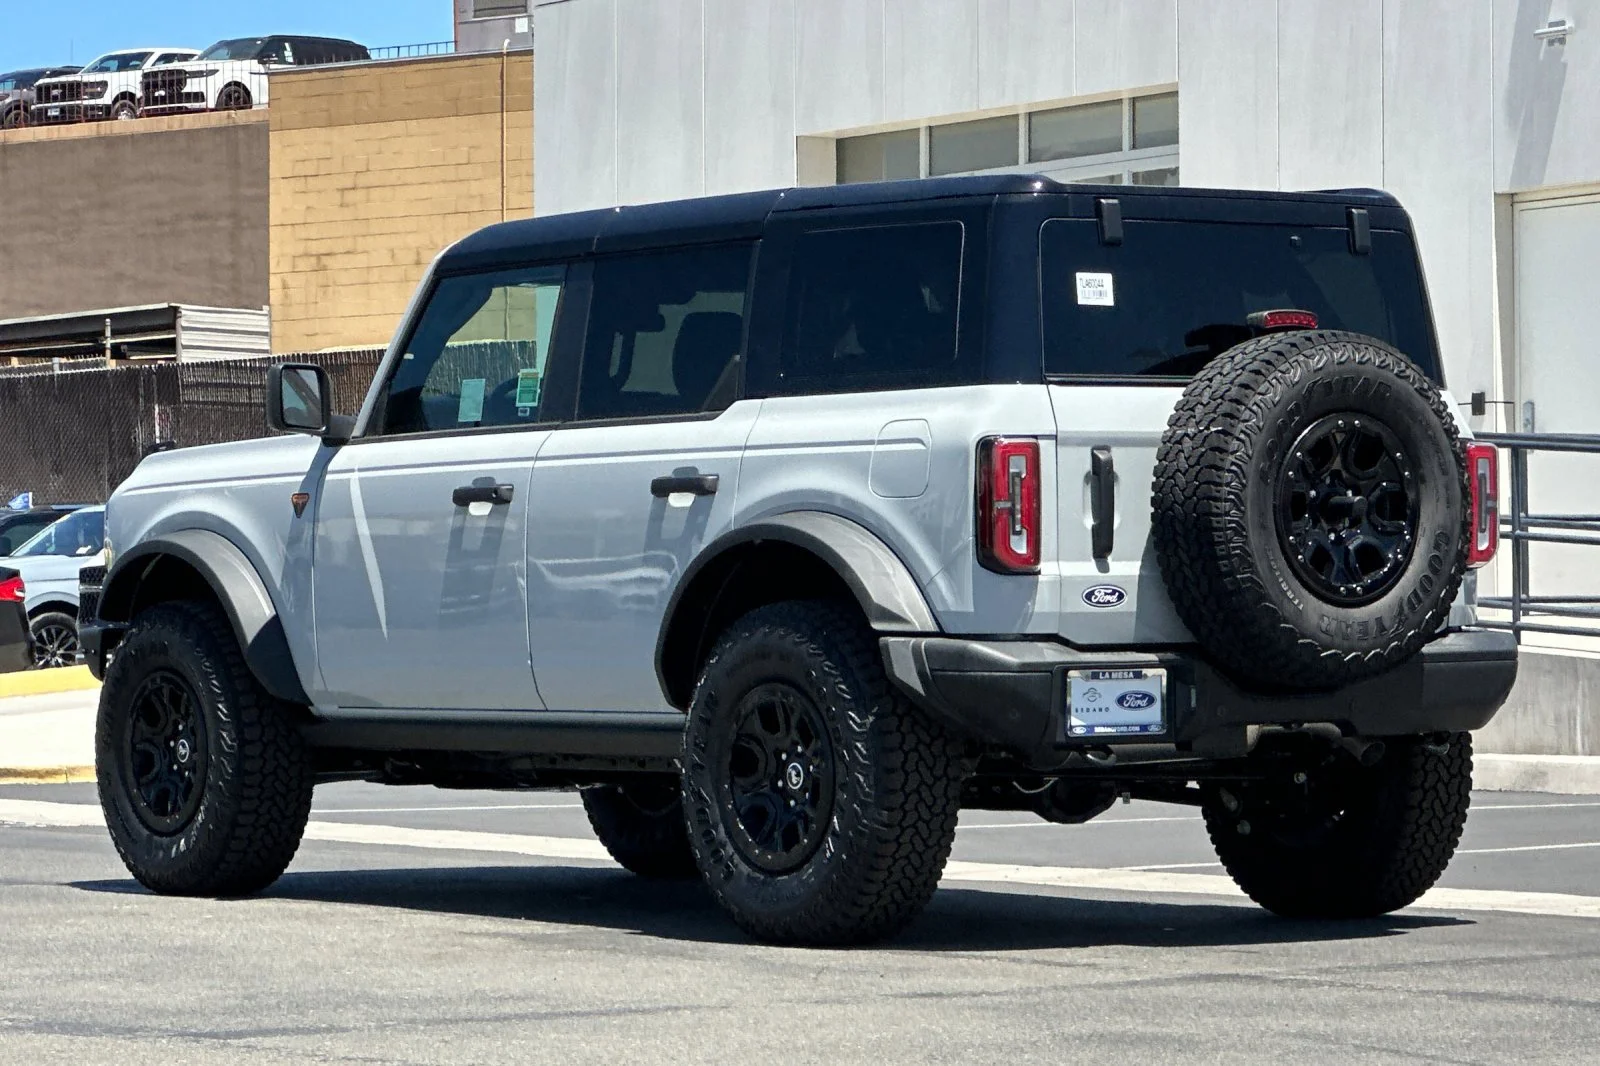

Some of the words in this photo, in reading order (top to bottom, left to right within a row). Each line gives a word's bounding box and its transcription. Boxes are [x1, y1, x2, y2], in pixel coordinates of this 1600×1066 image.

[1091, 589, 1119, 603] Ford
[1099, 672, 1110, 680] LA
[1111, 671, 1135, 680] MESA
[1123, 694, 1149, 708] Ford
